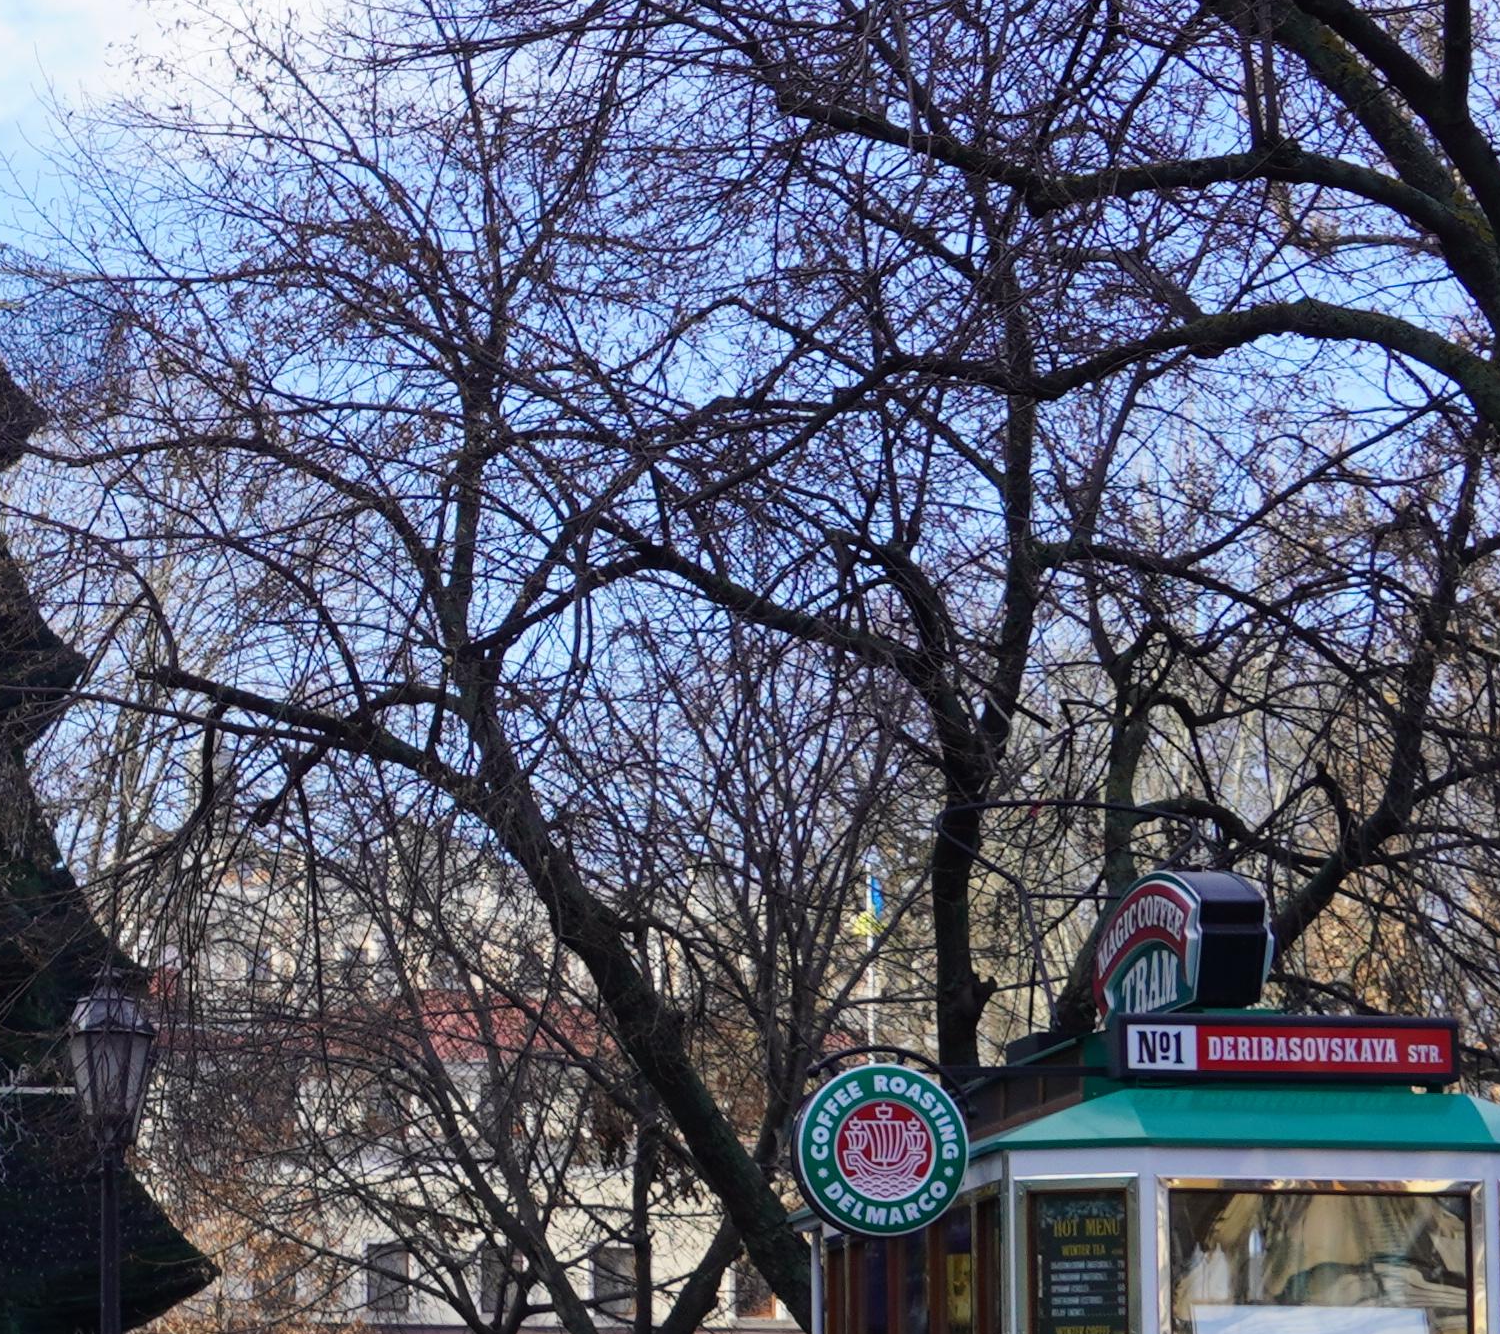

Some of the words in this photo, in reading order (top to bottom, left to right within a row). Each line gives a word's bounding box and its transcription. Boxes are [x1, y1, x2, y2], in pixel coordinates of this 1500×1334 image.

[1098, 903, 1137, 979] MAGIC
[1137, 894, 1185, 941] COFFEE
[1122, 950, 1178, 1013] TRAM
[1207, 1035, 1398, 1063] DERIBASOVSKAYA
[1407, 1044, 1443, 1063] STR.
[810, 1080, 864, 1161] COFFEE
[873, 1074, 959, 1160] ROASTING
[823, 1180, 947, 1226] DELMARCO
[1053, 1219, 1078, 1237] HOT
[1085, 1218, 1120, 1236] MENU
